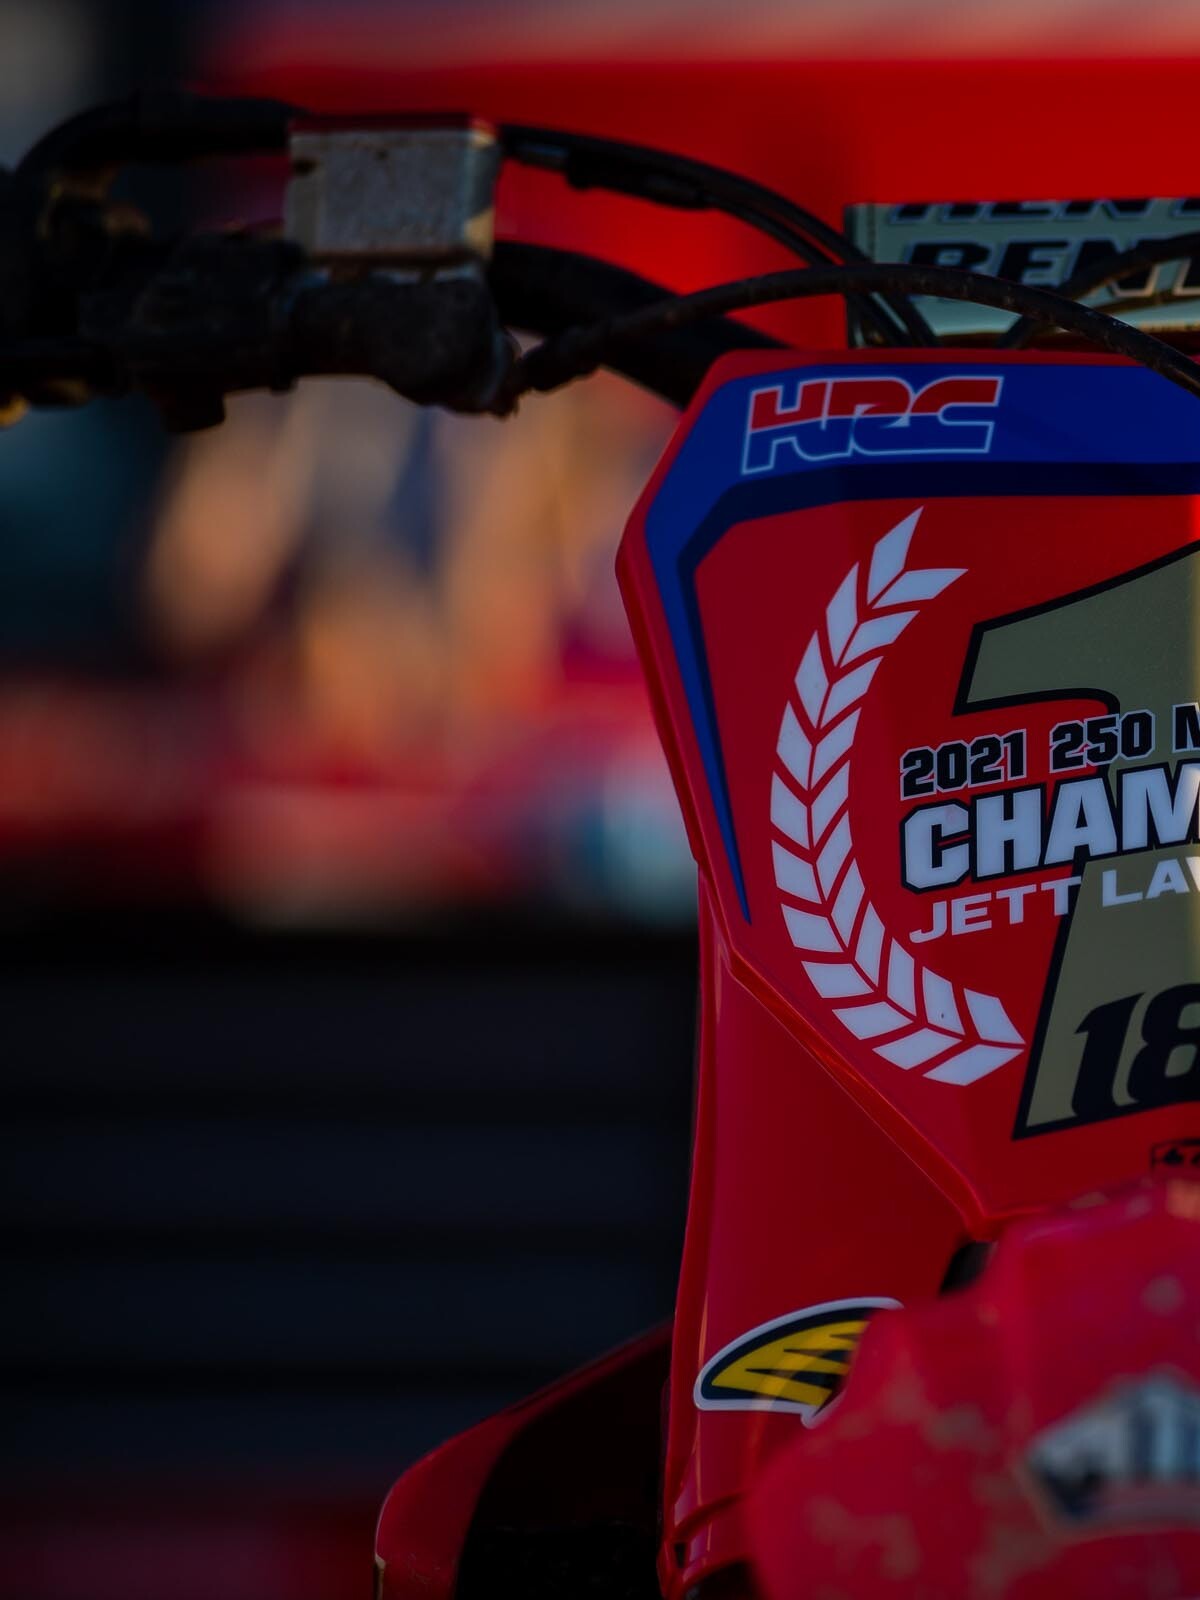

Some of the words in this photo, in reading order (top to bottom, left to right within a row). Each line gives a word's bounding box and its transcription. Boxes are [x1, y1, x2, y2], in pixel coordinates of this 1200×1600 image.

[741, 376, 1004, 475] HRC
[900, 729, 1027, 800] 2021
[1049, 709, 1155, 774] 250
[909, 876, 1082, 943] JETT
